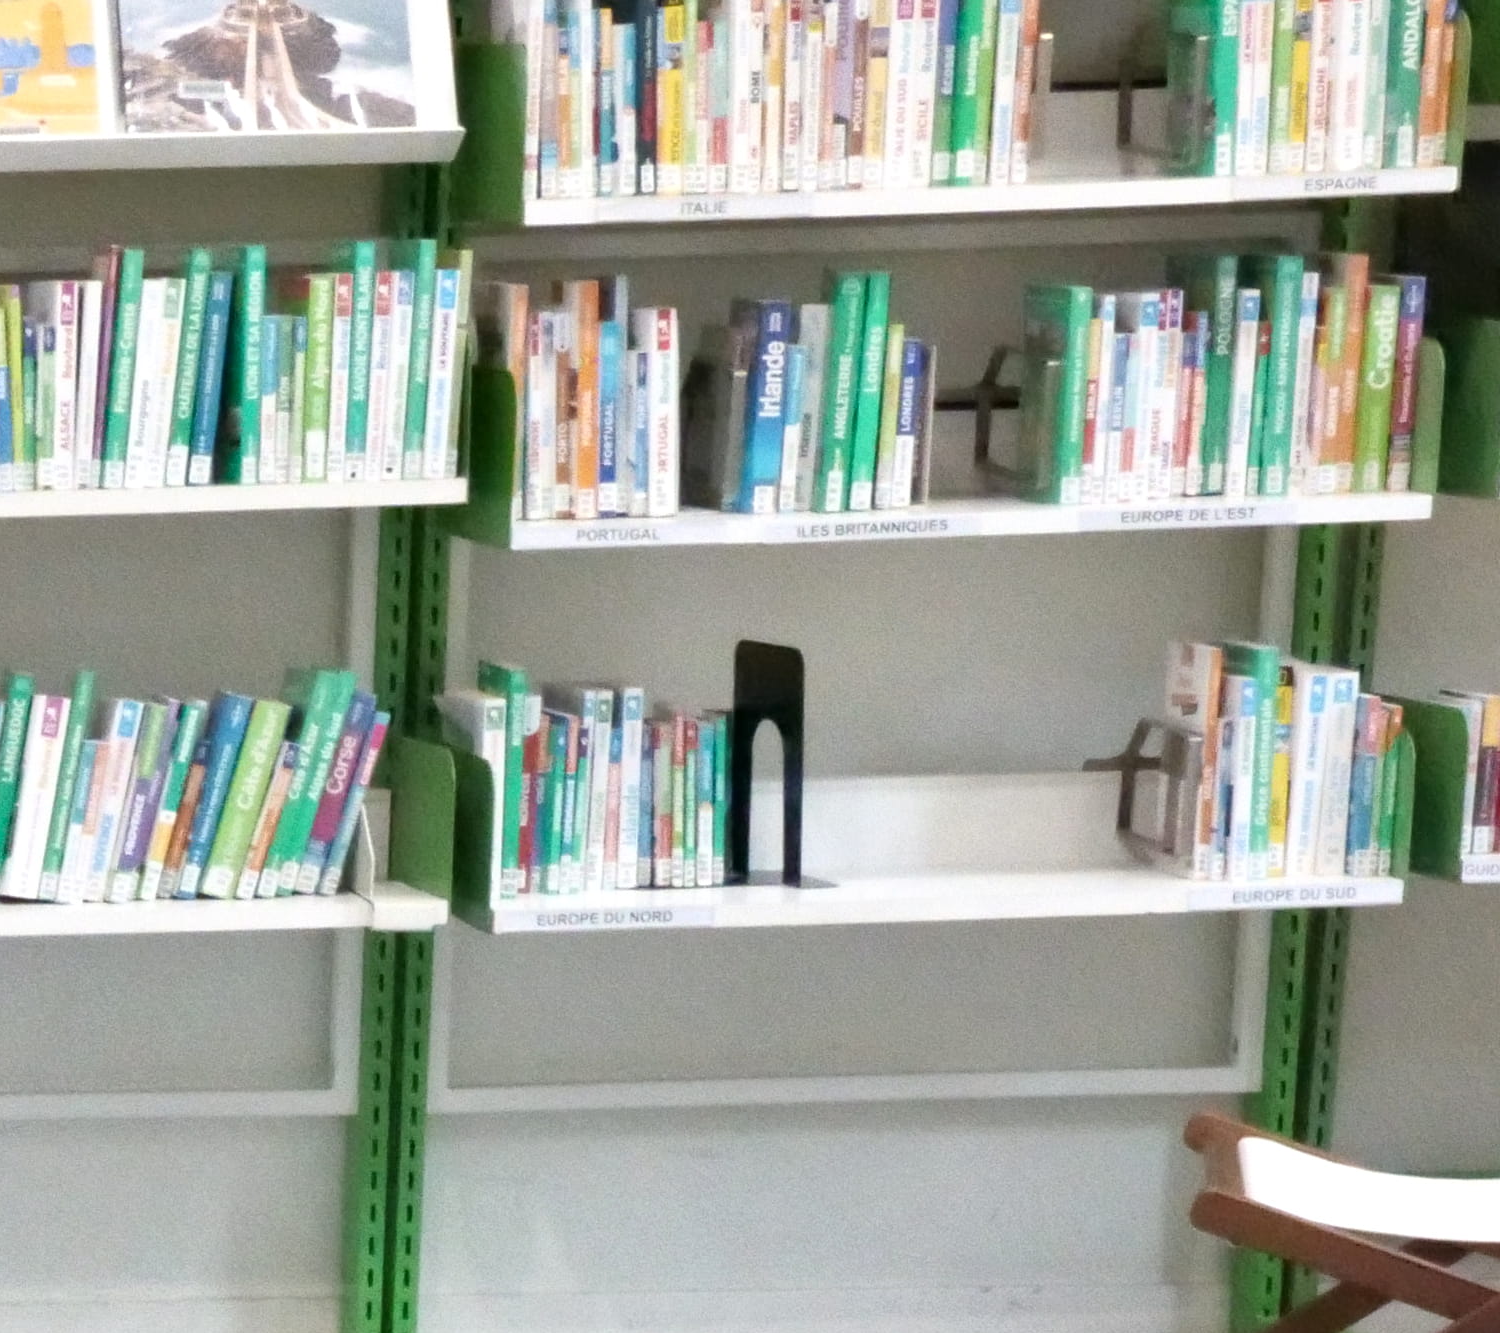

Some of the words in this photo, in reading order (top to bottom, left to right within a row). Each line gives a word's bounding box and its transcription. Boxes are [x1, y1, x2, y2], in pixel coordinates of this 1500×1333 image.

[1304, 176, 1377, 191] ESPAGNE
[680, 201, 727, 214] ITALIE
[1215, 279, 1234, 356] POLOGNE
[244, 345, 260, 362] ET
[863, 326, 884, 393] Londres
[1366, 293, 1395, 391] Croatie
[244, 365, 260, 400] LYON
[311, 345, 330, 389] Alpes
[759, 340, 785, 418] Irlande
[833, 355, 853, 440] ANGLETERRE
[900, 375, 914, 432] LONDRES
[1085, 382, 1097, 421] BERLIN
[1112, 385, 1124, 428] BERLIN
[59, 400, 71, 452] ALSACE
[603, 401, 615, 466] PORTUGAL
[576, 527, 660, 542] PORTUGAL
[796, 524, 830, 539] ILES
[835, 519, 949, 536] BRITANNIQUES
[1120, 510, 1183, 525] EUROPE
[1189, 508, 1212, 522] DE
[1214, 507, 1256, 521] L'EST
[1, 698, 24, 783] LANGUEDOC
[326, 712, 342, 739] Sud
[236, 766, 260, 811] Côte
[248, 709, 278, 765] d'Azur
[319, 740, 334, 760] du
[325, 734, 356, 795] Corse
[287, 768, 305, 800] Côte
[308, 762, 328, 801] Alpes
[1255, 788, 1268, 825] Grèce
[1232, 889, 1294, 904] EUROPE
[1299, 888, 1321, 901] DU
[1325, 886, 1357, 900] SUD
[536, 912, 599, 927] EUROPE
[603, 911, 625, 925] DU
[629, 910, 673, 924] NORD
